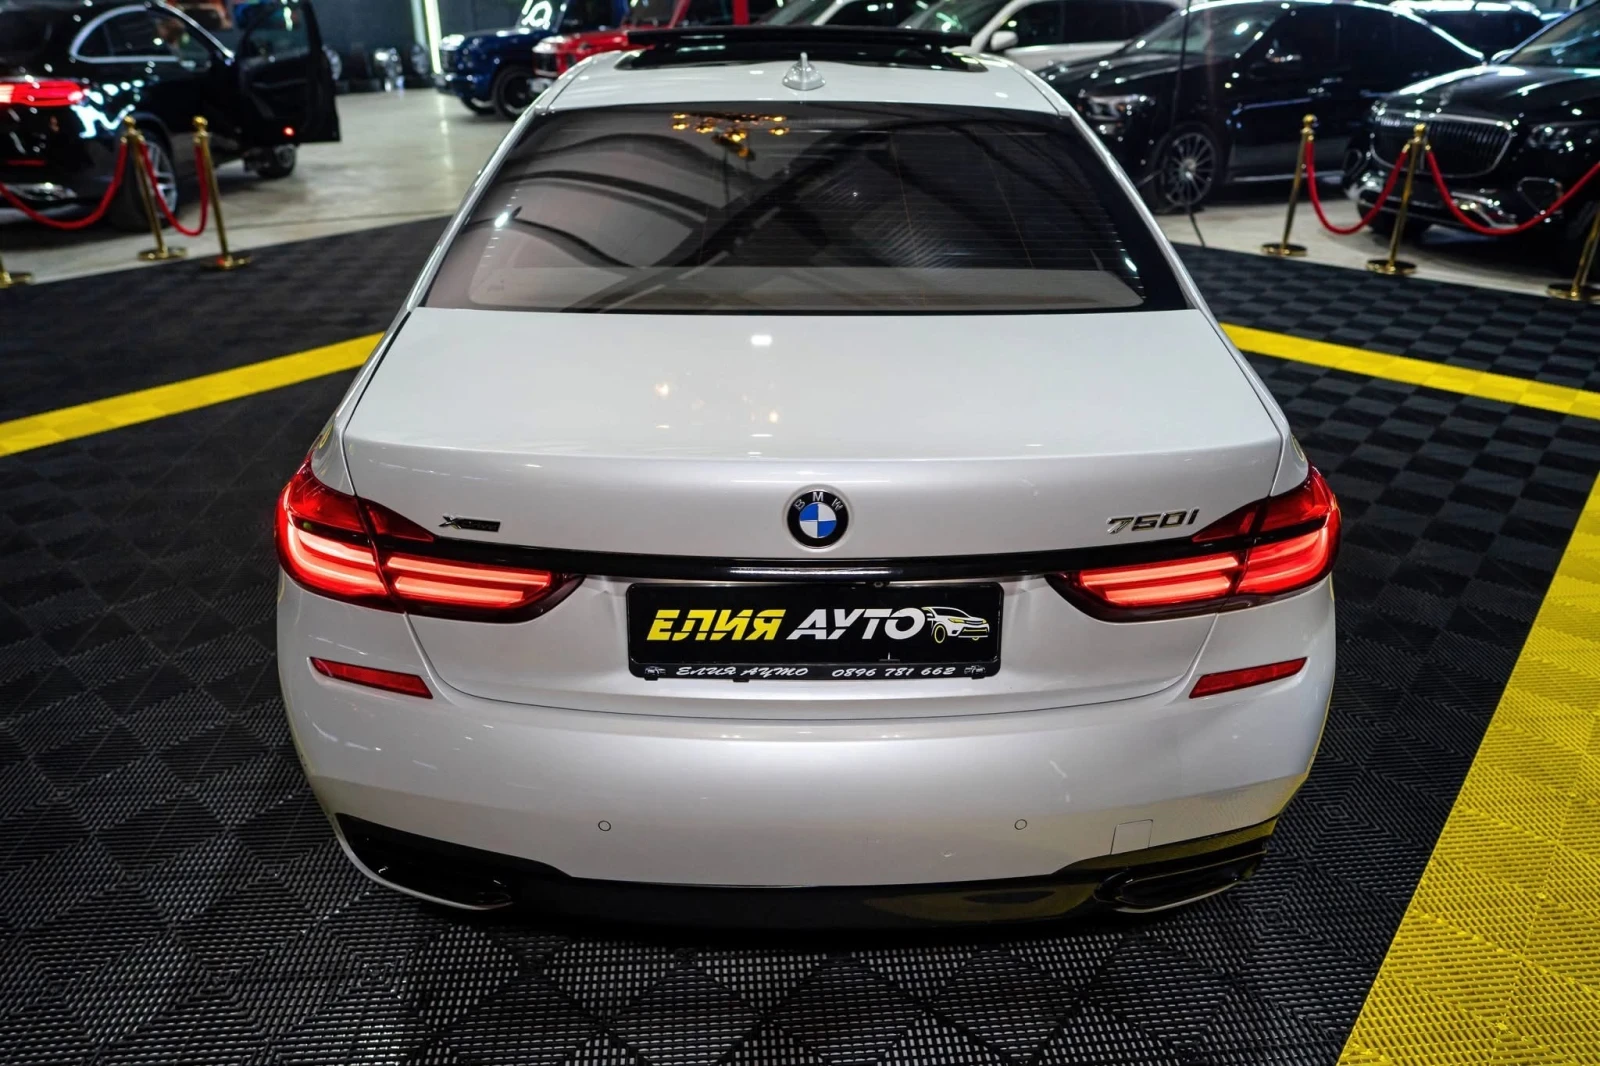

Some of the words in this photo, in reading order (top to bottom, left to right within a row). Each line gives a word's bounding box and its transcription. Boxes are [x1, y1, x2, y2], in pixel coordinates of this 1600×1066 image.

[793, 491, 843, 511] BMW
[646, 609, 786, 642] ЕЛИЯ
[786, 608, 926, 641] АУТО
[831, 668, 877, 677] 0896
[884, 668, 915, 676] 781
[920, 667, 956, 676] 662
